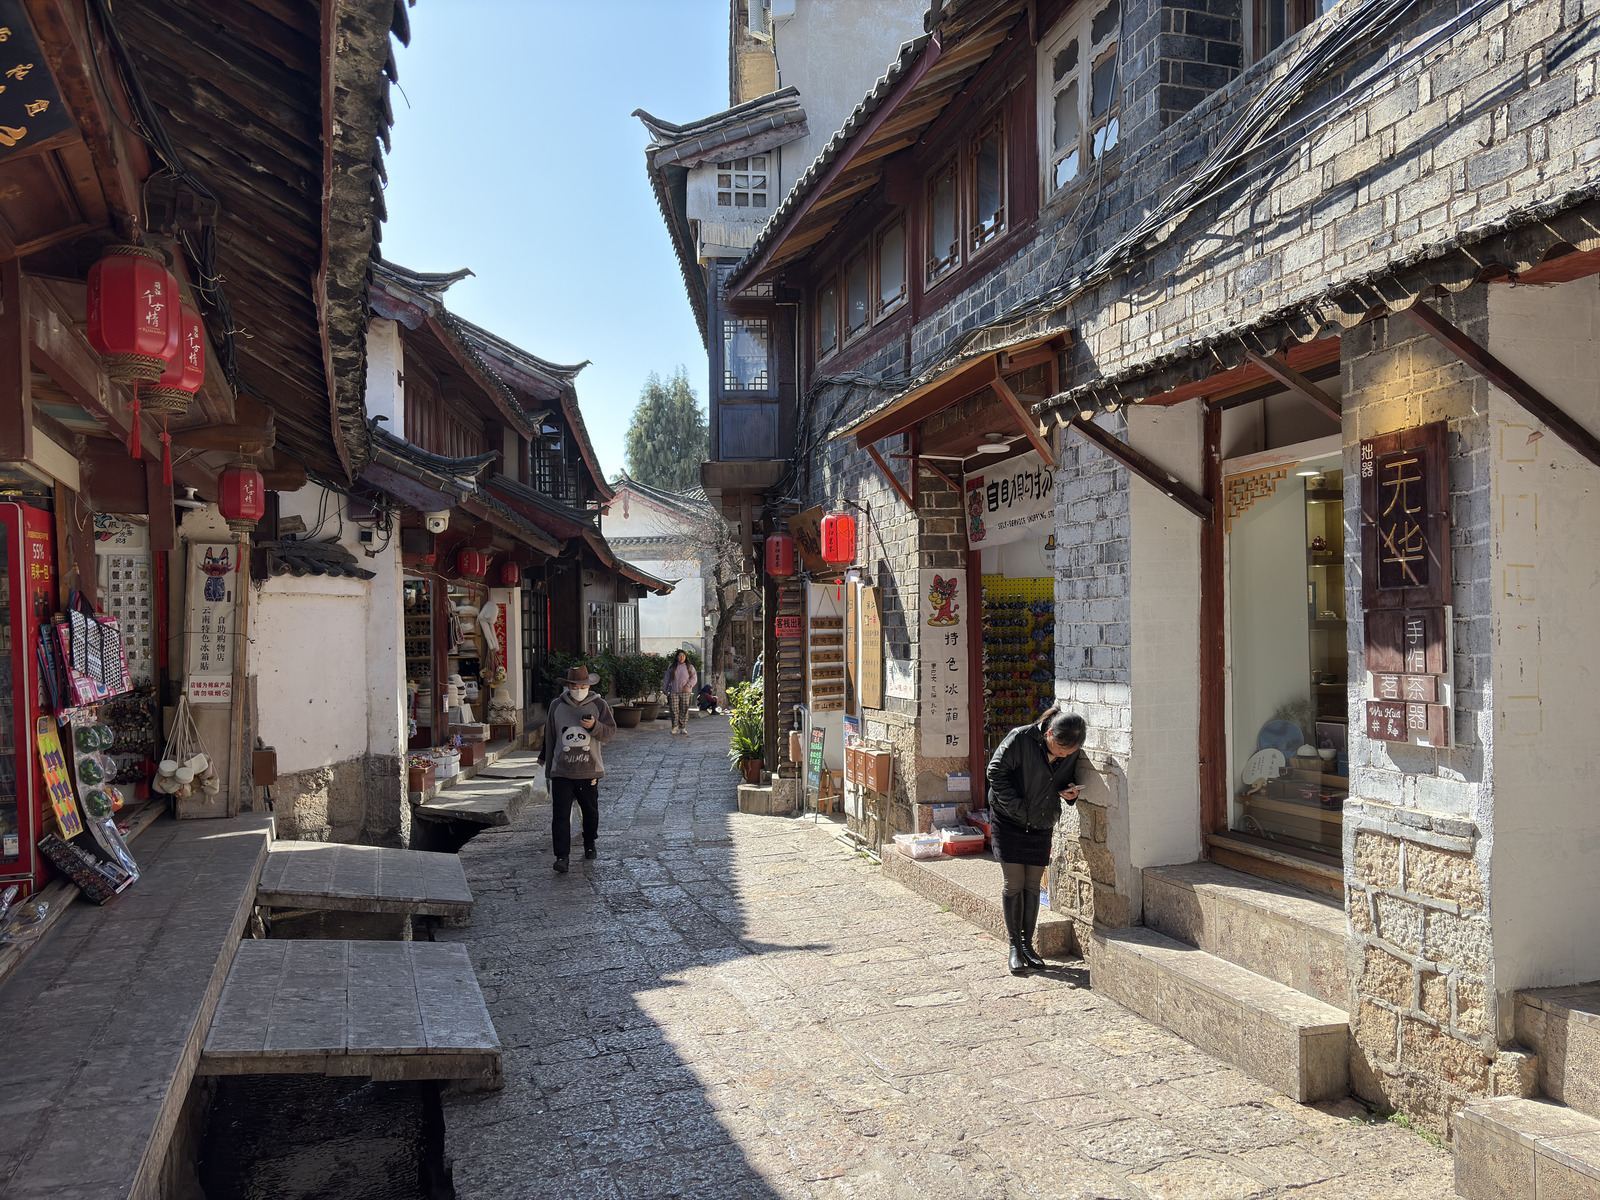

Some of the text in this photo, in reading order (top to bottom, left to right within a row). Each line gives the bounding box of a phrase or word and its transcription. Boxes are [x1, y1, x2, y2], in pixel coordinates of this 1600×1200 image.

[141, 289, 165, 328] 千古情
[186, 332, 201, 367] 千古情
[1361, 443, 1374, 478] 拙器
[997, 516, 1027, 530] SELF-SERVICE
[1027, 511, 1048, 524] SHOPPING
[1382, 457, 1424, 580] 无华
[32, 543, 45, 560] 55%
[31, 563, 50, 580] 再来一包
[216, 616, 226, 661] 自助购物店
[1384, 707, 1401, 719] Hua
